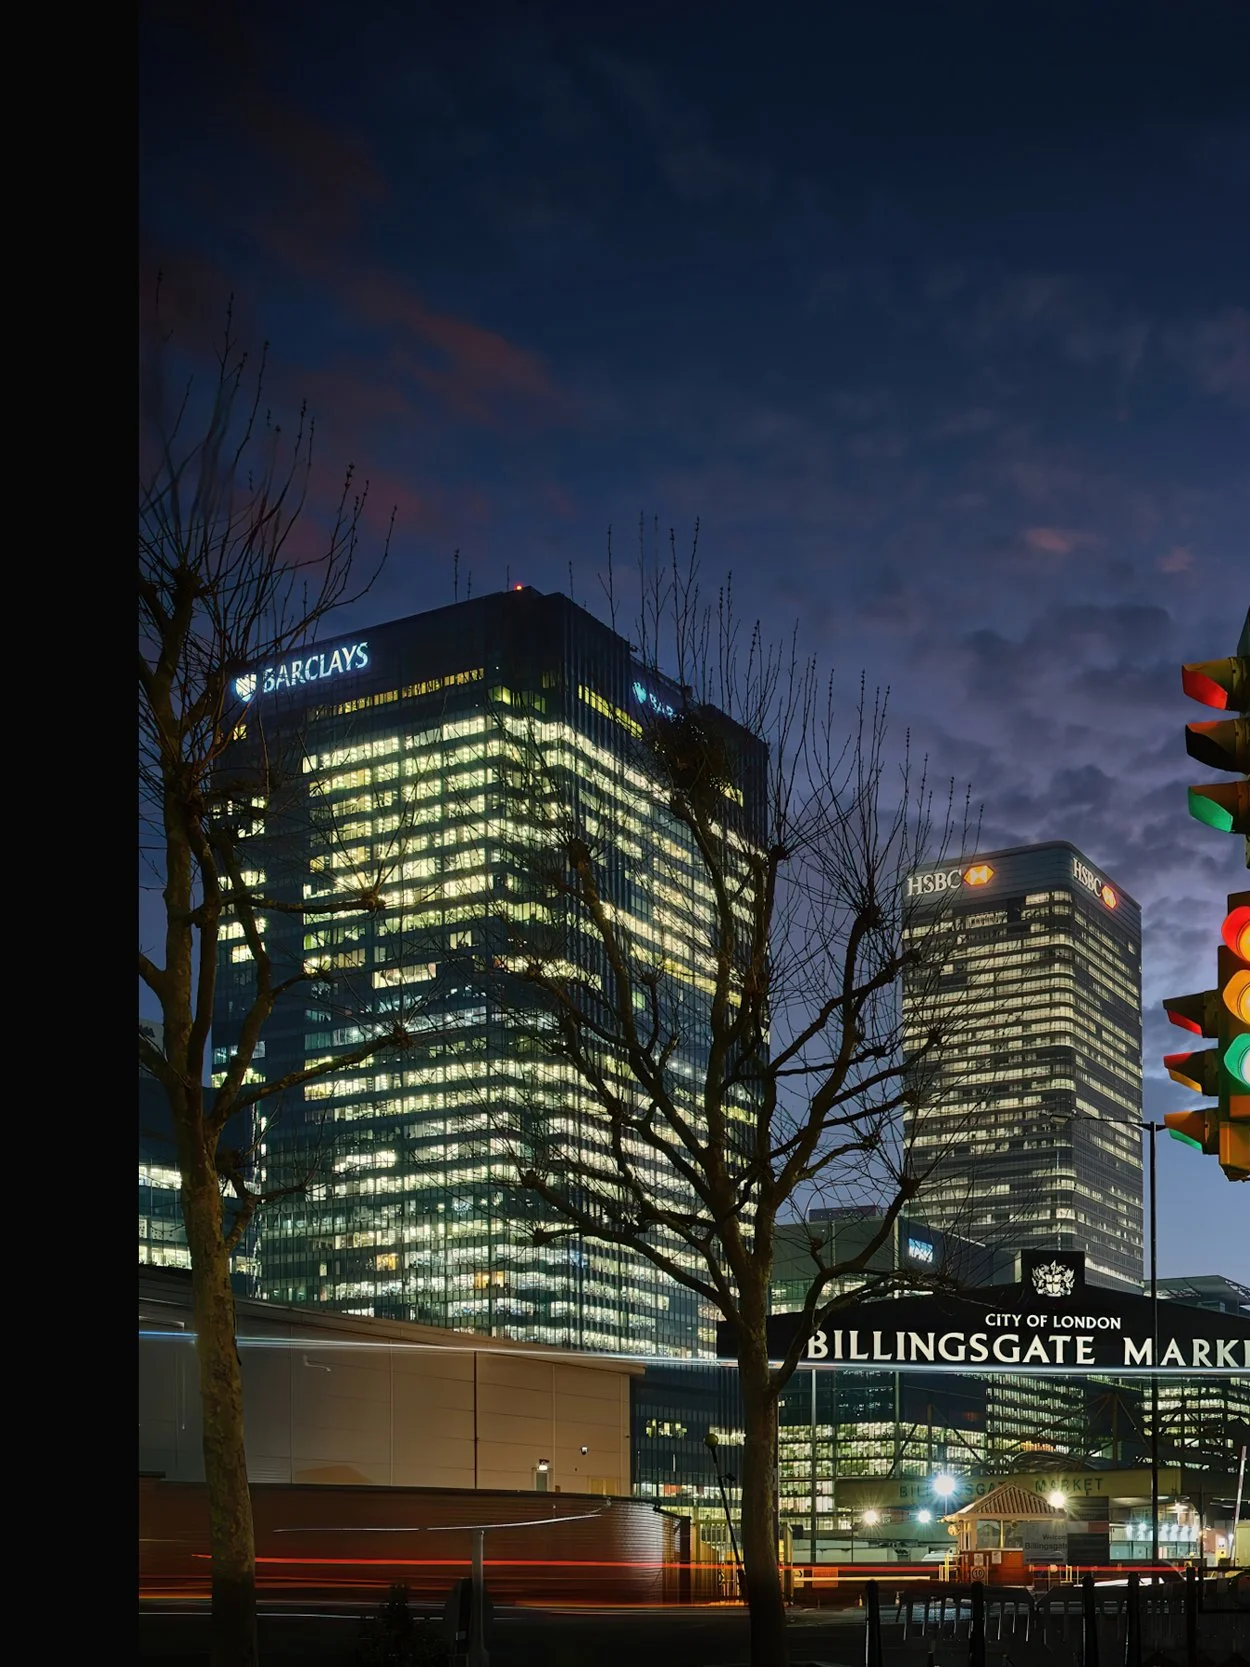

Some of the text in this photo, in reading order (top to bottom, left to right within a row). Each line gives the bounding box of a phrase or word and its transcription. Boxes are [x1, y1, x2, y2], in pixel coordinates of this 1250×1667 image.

[263, 642, 368, 693] BARCLAYS
[907, 869, 962, 897] HSBC
[1072, 857, 1102, 897] HSBC
[985, 1313, 1122, 1330] CITY OF LONDON
[807, 1330, 1096, 1365] BILLINGSGATE
[1035, 1478, 1103, 1493] MARKET
